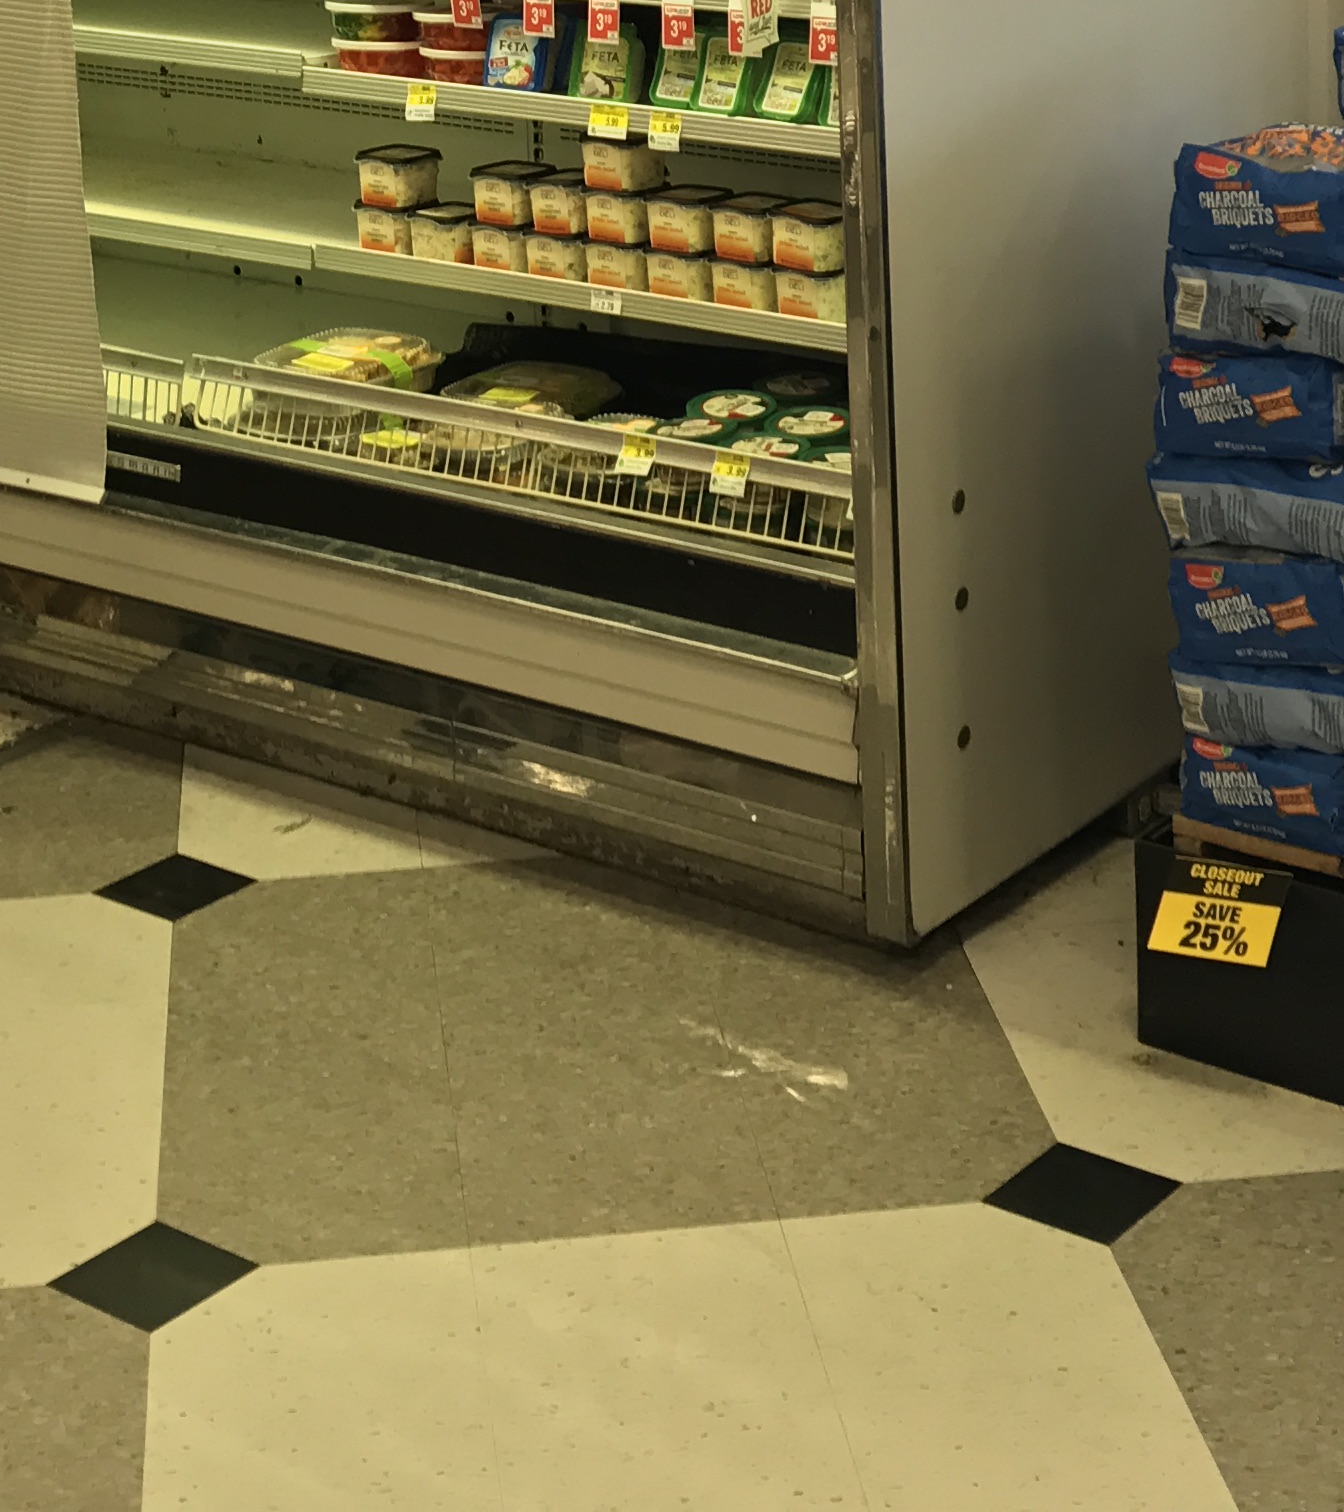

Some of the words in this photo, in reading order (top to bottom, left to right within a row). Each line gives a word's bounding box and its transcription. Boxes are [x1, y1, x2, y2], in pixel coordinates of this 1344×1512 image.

[499, 39, 529, 53] FETA
[592, 51, 620, 64] FETA
[713, 55, 739, 67] FETA
[782, 59, 807, 73] FETA
[1198, 189, 1264, 209] CHARCOAL
[1212, 207, 1275, 228] BRIQUETS
[1178, 382, 1243, 409] CHARCOAL
[1193, 398, 1254, 425] BRIQUETS
[1195, 592, 1256, 620] CHARCOAL
[1199, 770, 1263, 789] CHARCOAL
[1190, 862, 1266, 887] CLOSEOUT
[1203, 880, 1242, 899] SALE
[1192, 900, 1244, 925] SAVE
[1178, 919, 1250, 958] 25%
